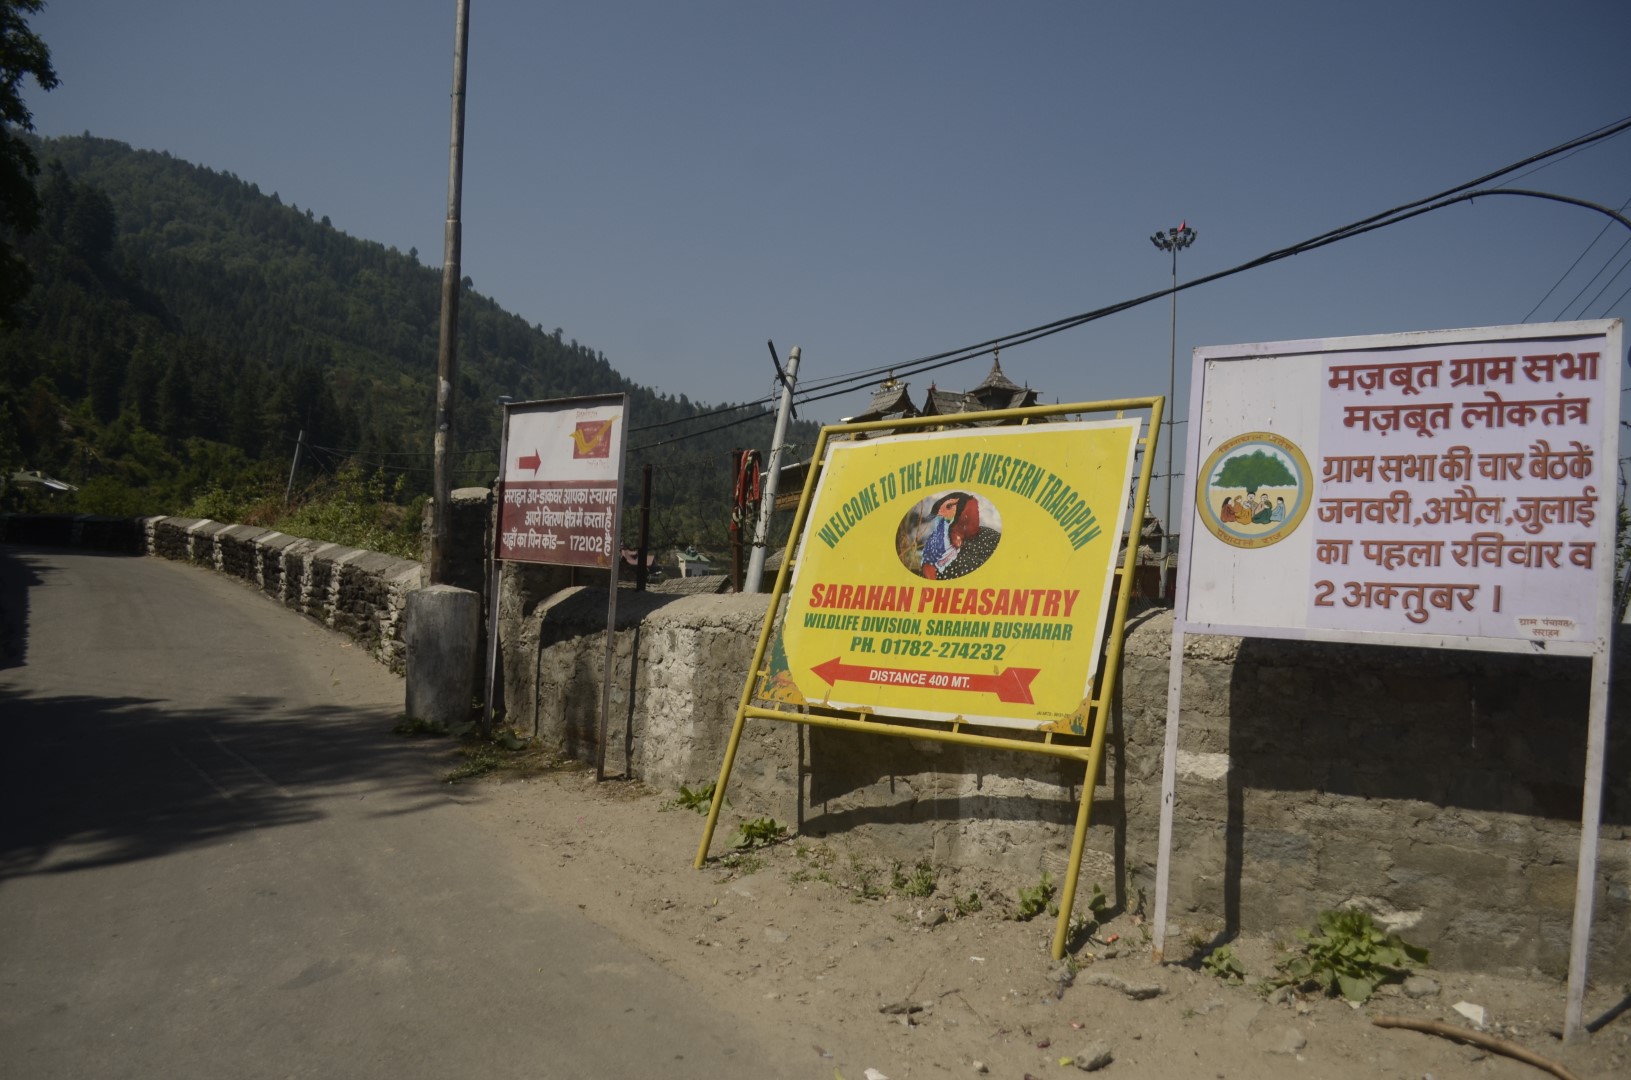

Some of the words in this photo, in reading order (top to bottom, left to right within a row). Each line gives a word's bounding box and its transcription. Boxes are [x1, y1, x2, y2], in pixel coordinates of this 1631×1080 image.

[1328, 360, 1442, 396] मज़बूत
[1450, 356, 1516, 388] ग्राम
[1522, 352, 1600, 383] सभा
[1343, 402, 1453, 438] मज़बूत
[1460, 391, 1590, 429] लोकतंत्र
[1322, 455, 1374, 484] ग्राम
[1378, 454, 1437, 483] सभा
[1438, 445, 1473, 482] की
[1478, 453, 1524, 482] चार
[1528, 439, 1594, 482] बैठकें
[563, 489, 588, 504] आपका
[589, 488, 617, 504] स्वागत
[818, 482, 880, 550] WELCOME
[880, 472, 897, 504] TO
[899, 460, 922, 494] THE
[925, 454, 959, 487] LAND
[960, 452, 980, 484] OF
[977, 453, 1046, 499] WESTERN
[1034, 472, 1102, 551] TRAGOPAN
[525, 506, 541, 526] अपने
[542, 506, 564, 527] वितरण
[584, 512, 605, 528] करता
[517, 532, 527, 548] का
[528, 528, 542, 548] पिन
[570, 535, 602, 552] 172102
[1316, 539, 1353, 565] का
[1360, 540, 1444, 570] पहला
[1451, 532, 1563, 569] रविवार
[1568, 542, 1596, 569] व
[809, 584, 914, 612] SARAHAN
[918, 587, 1080, 617] PHEASANTRY
[1314, 580, 1335, 607] 2
[1342, 581, 1480, 624] अक्तुबर
[804, 613, 860, 631] WILDLIFE
[860, 616, 922, 636] DIVISION,
[926, 619, 990, 638] SARAHAN
[992, 622, 1073, 641] BUSHAHAR
[1518, 618, 1537, 626] ग्राम
[850, 636, 876, 654] PH.
[880, 638, 1006, 660] 01782-274232
[870, 669, 926, 686] DISTANCE
[928, 674, 949, 686] 400
[951, 676, 970, 688] MT.
